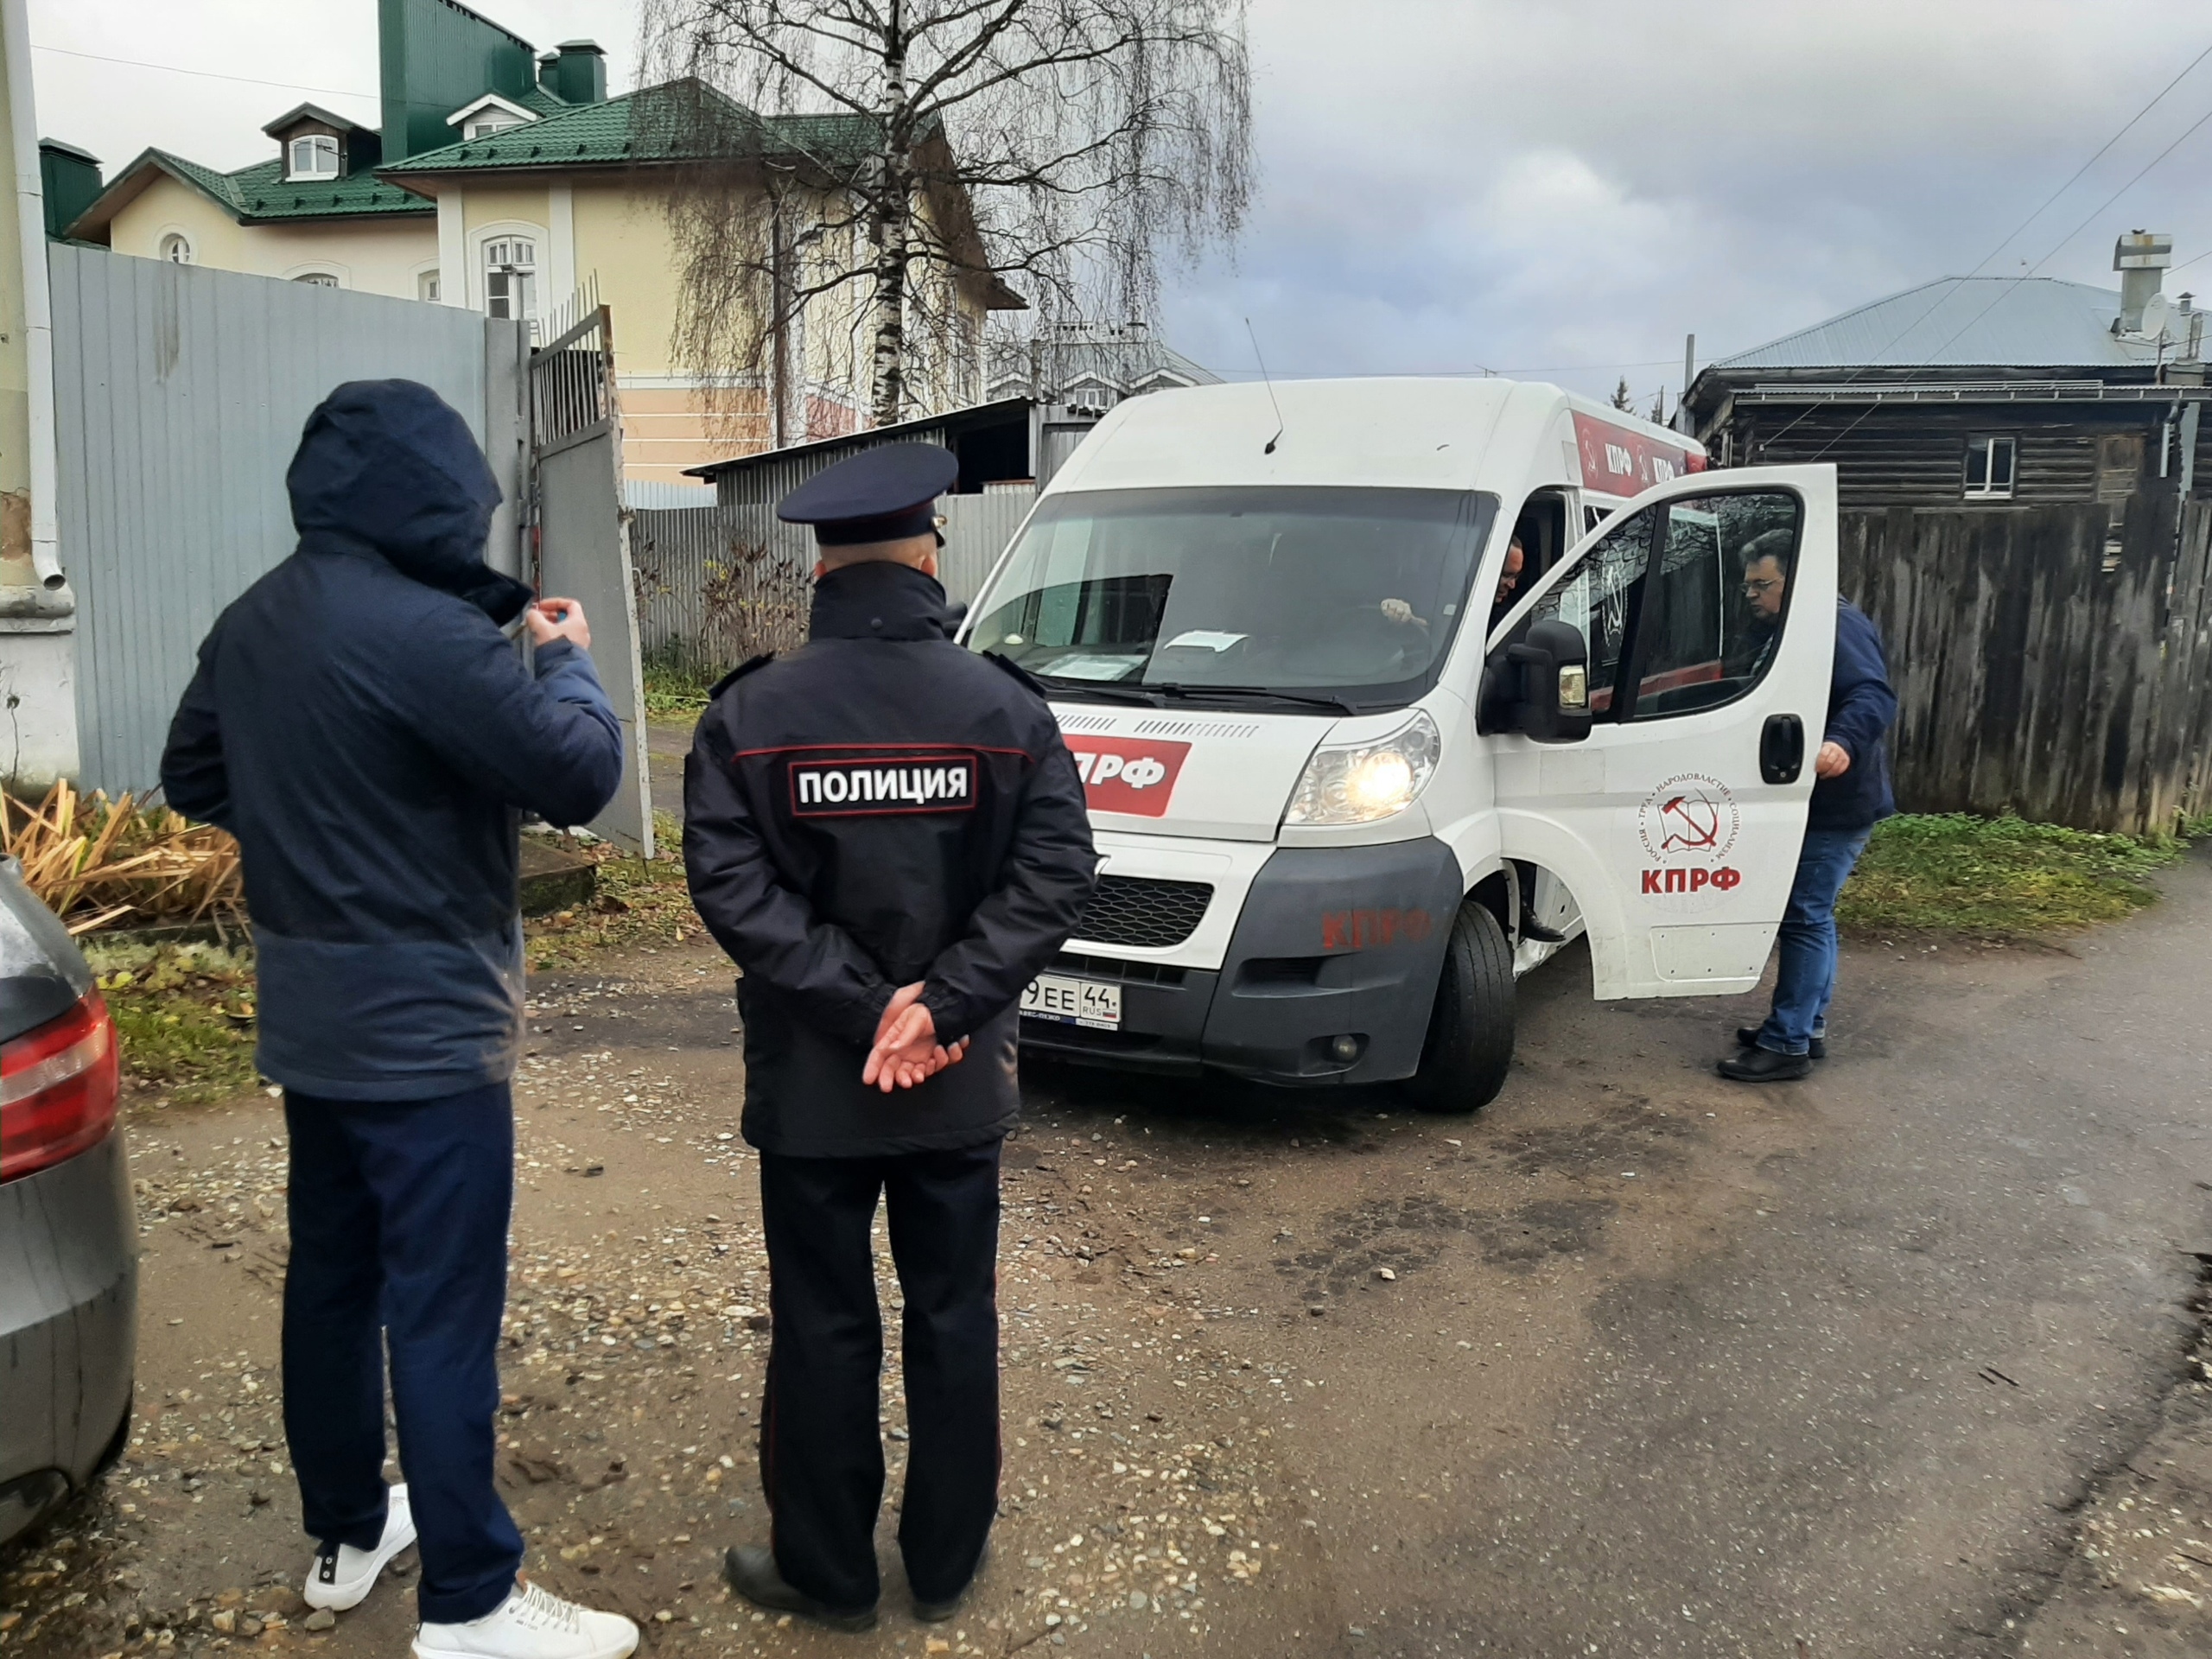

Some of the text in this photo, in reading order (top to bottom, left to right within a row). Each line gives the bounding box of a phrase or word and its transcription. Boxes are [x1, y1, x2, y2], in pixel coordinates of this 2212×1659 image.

[1605, 442, 1633, 477] КПРФ
[798, 766, 968, 805] ПОЛИЦИЯ
[1074, 751, 1166, 790] ПРФ
[1656, 772, 1732, 797] НАРОДОВЛАСТИЕ
[1638, 798, 1653, 819] ТРУД
[1638, 829, 1663, 862] РОССИЯ
[1715, 802, 1740, 861] СОЦИАЛИЗМ
[1642, 866, 1741, 894] КПРФ
[1083, 1006, 1102, 1016] RUS
